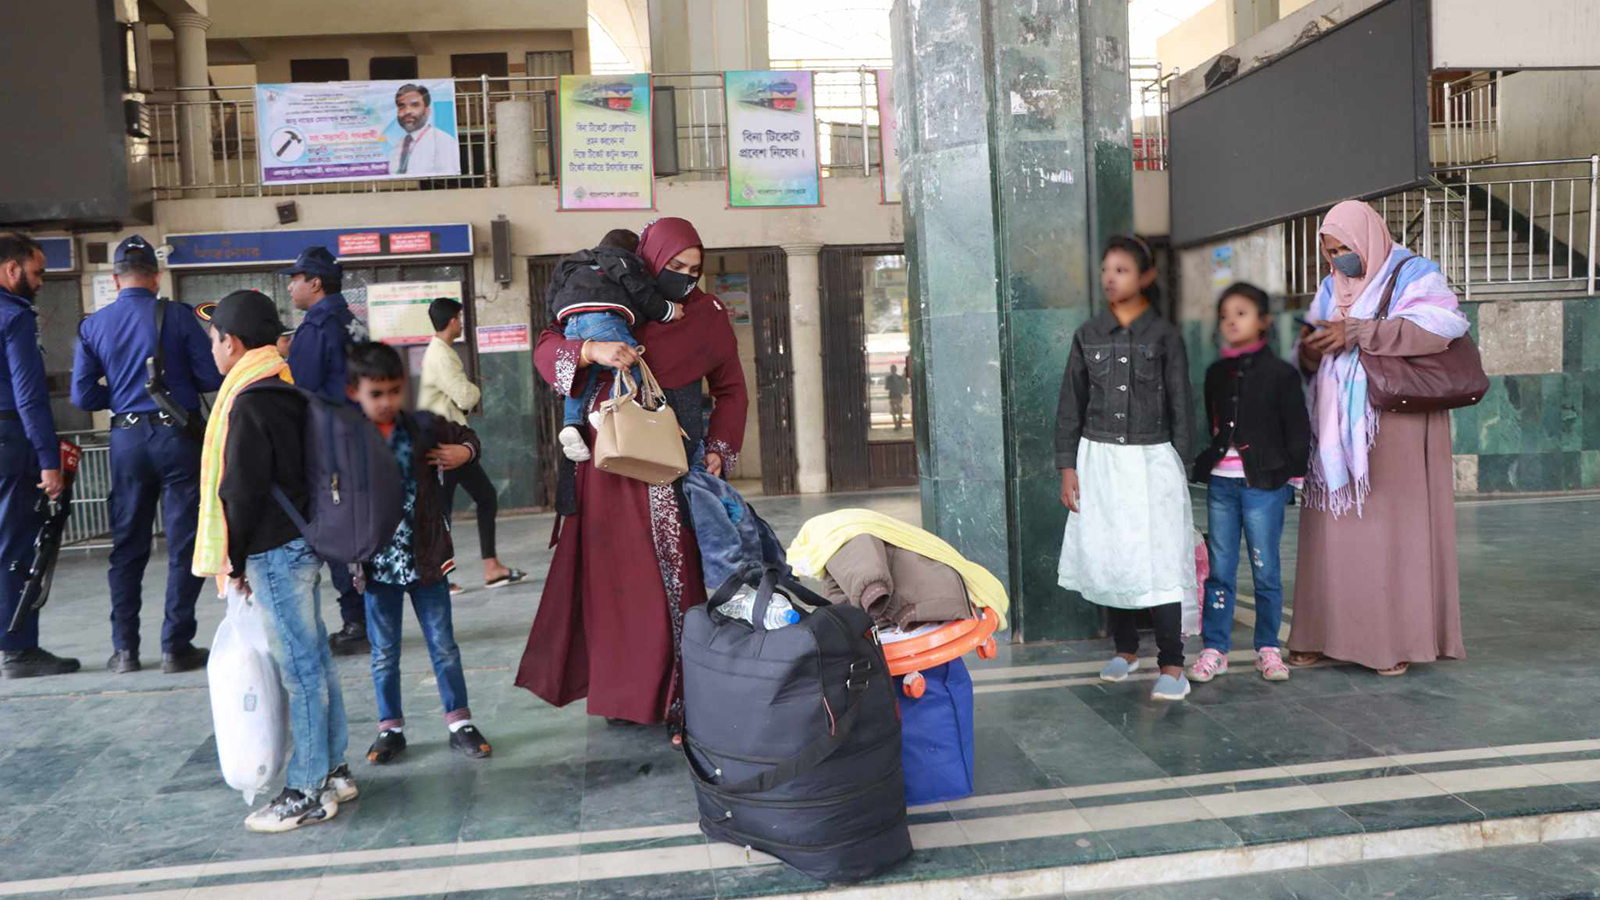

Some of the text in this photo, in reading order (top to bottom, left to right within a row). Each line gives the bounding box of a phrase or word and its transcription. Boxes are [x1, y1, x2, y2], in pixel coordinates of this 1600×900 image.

[741, 128, 802, 143] বিনা টিকেটে
[738, 147, 767, 160] প্রবেশ
